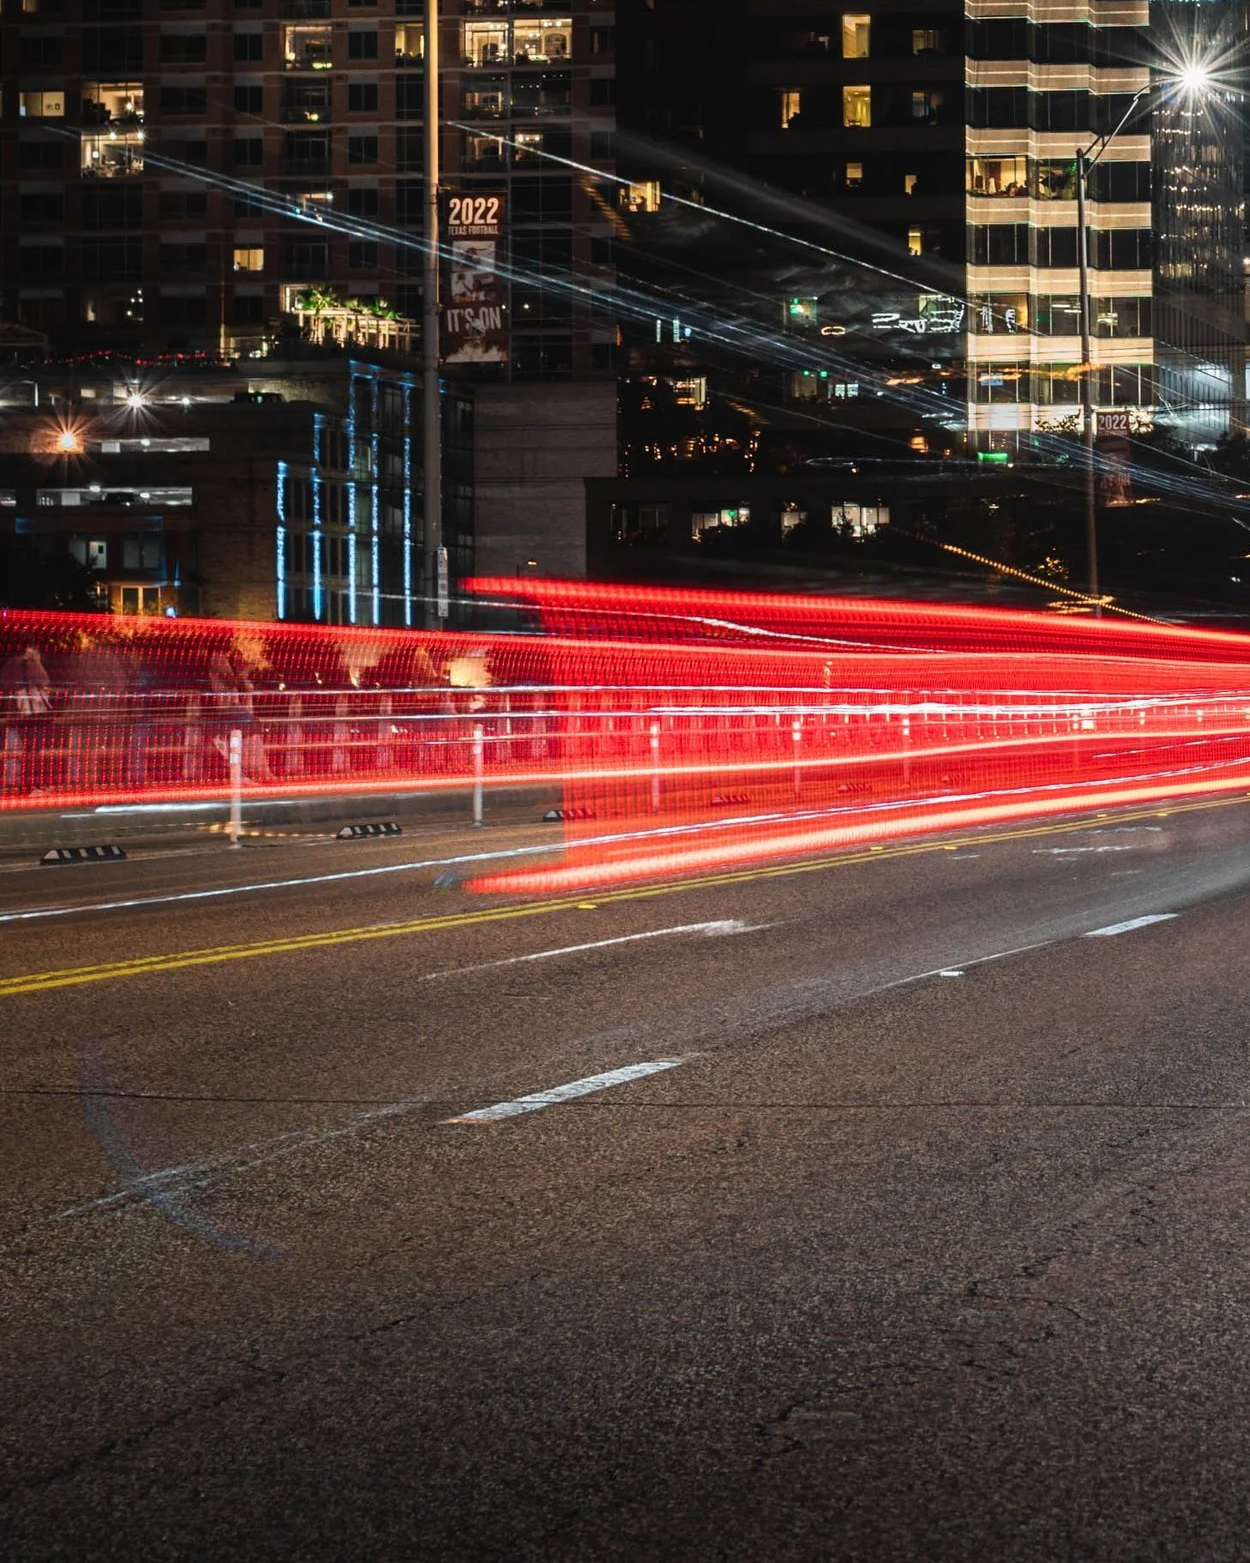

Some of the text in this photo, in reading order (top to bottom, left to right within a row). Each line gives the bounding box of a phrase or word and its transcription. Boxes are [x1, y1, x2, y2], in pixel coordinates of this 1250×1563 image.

[448, 197, 499, 225] 2022
[448, 225, 499, 236] TEXAS FOOTBALL
[479, 306, 502, 330] ON
[1098, 414, 1128, 430] 2022
